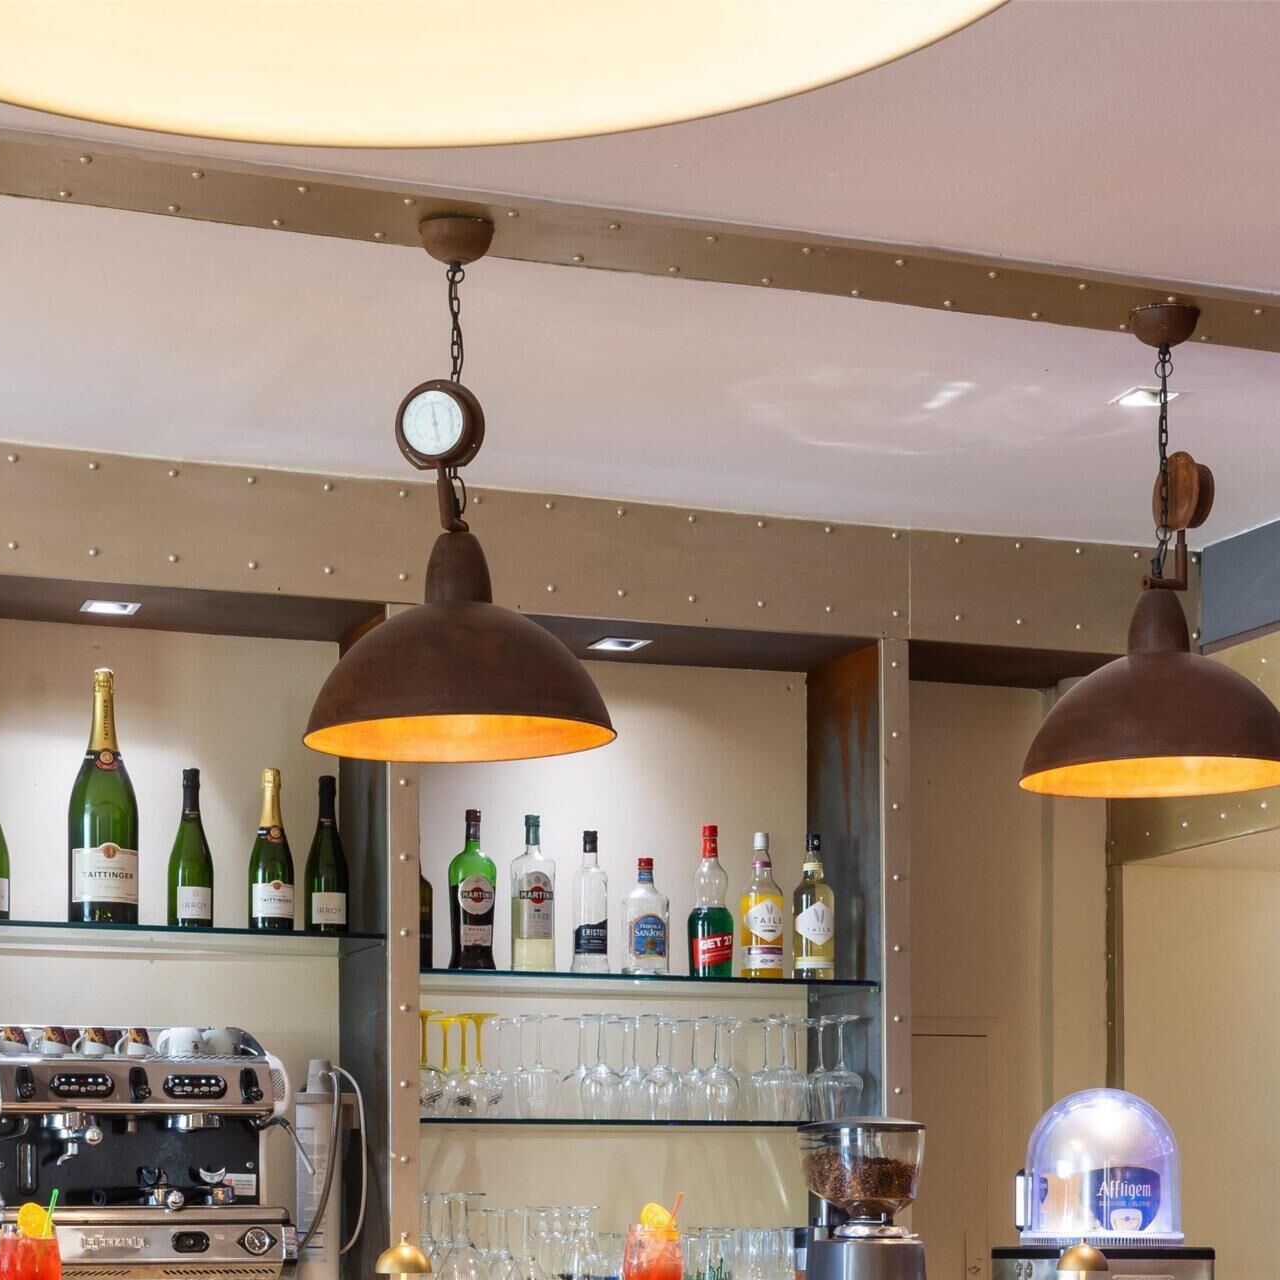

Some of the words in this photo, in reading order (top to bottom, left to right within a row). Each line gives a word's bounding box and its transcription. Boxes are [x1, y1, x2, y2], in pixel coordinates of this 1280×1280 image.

[81, 871, 134, 881] TAITTINGER
[462, 890, 493, 899] MARTINI
[520, 890, 553, 899] MARTINI
[181, 901, 208, 910] IRROY
[316, 907, 342, 915] IRROY
[701, 938, 722, 950] GET
[723, 935, 733, 946] 27
[1096, 1181, 1151, 1200] Affligem
